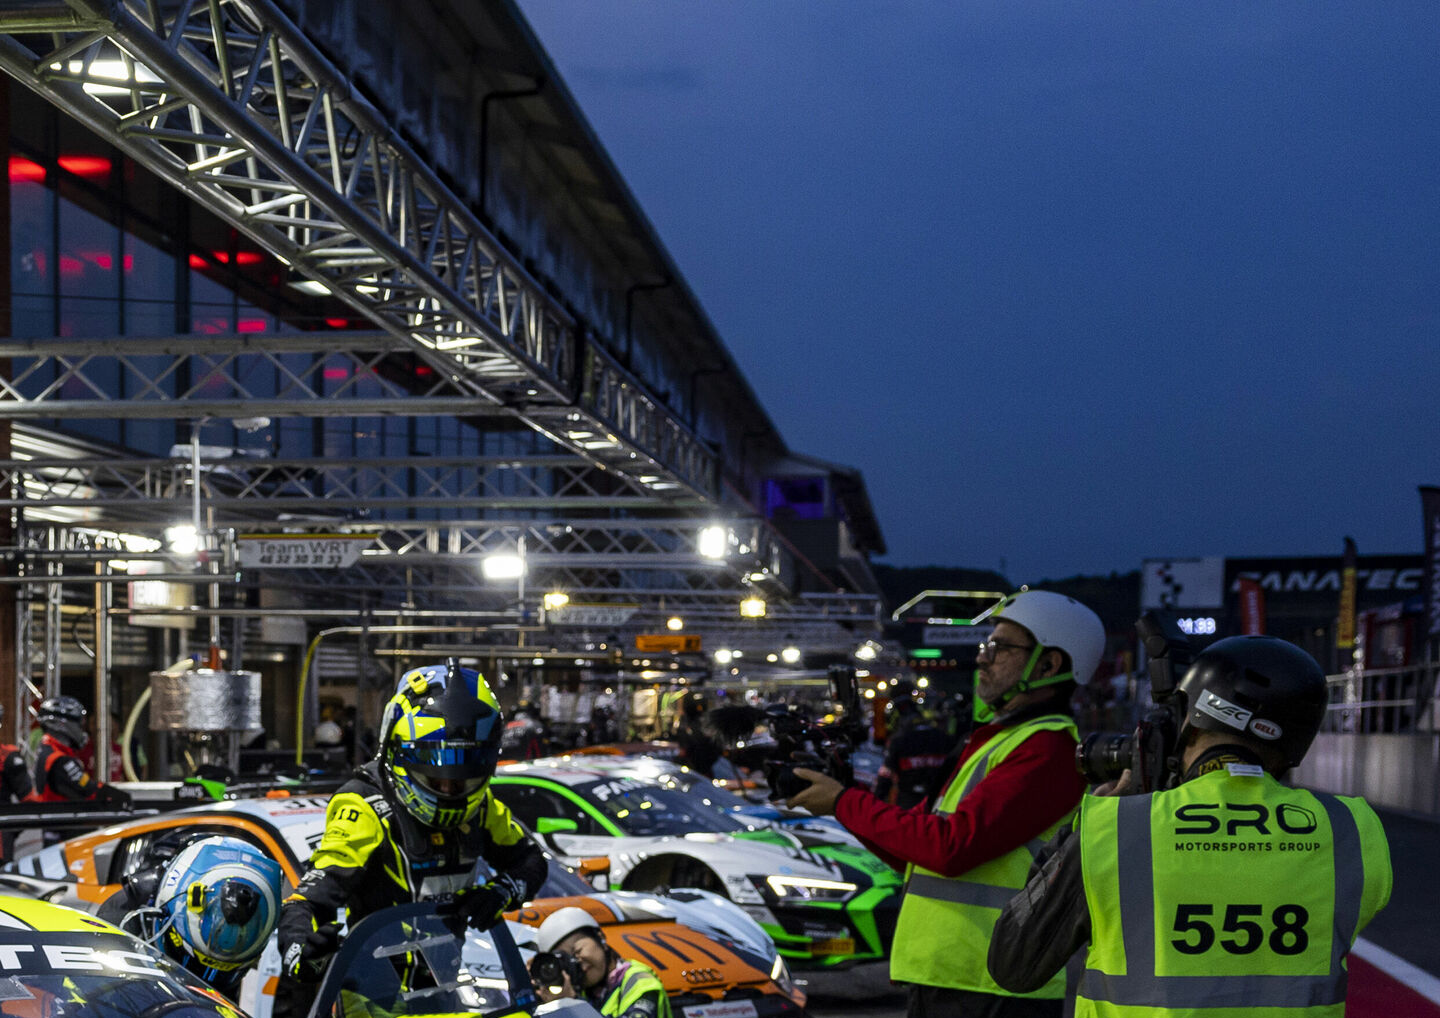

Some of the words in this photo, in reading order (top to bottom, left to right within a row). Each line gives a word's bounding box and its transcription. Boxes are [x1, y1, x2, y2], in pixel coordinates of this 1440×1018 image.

[258, 540, 307, 555] Team
[309, 540, 353, 554] WRT
[1254, 722, 1277, 737] BELL
[1174, 803, 1318, 836] SRO
[1175, 842, 1273, 852] MOTORSPORTS
[1279, 842, 1321, 852] GROUP
[1170, 903, 1310, 956] 558
